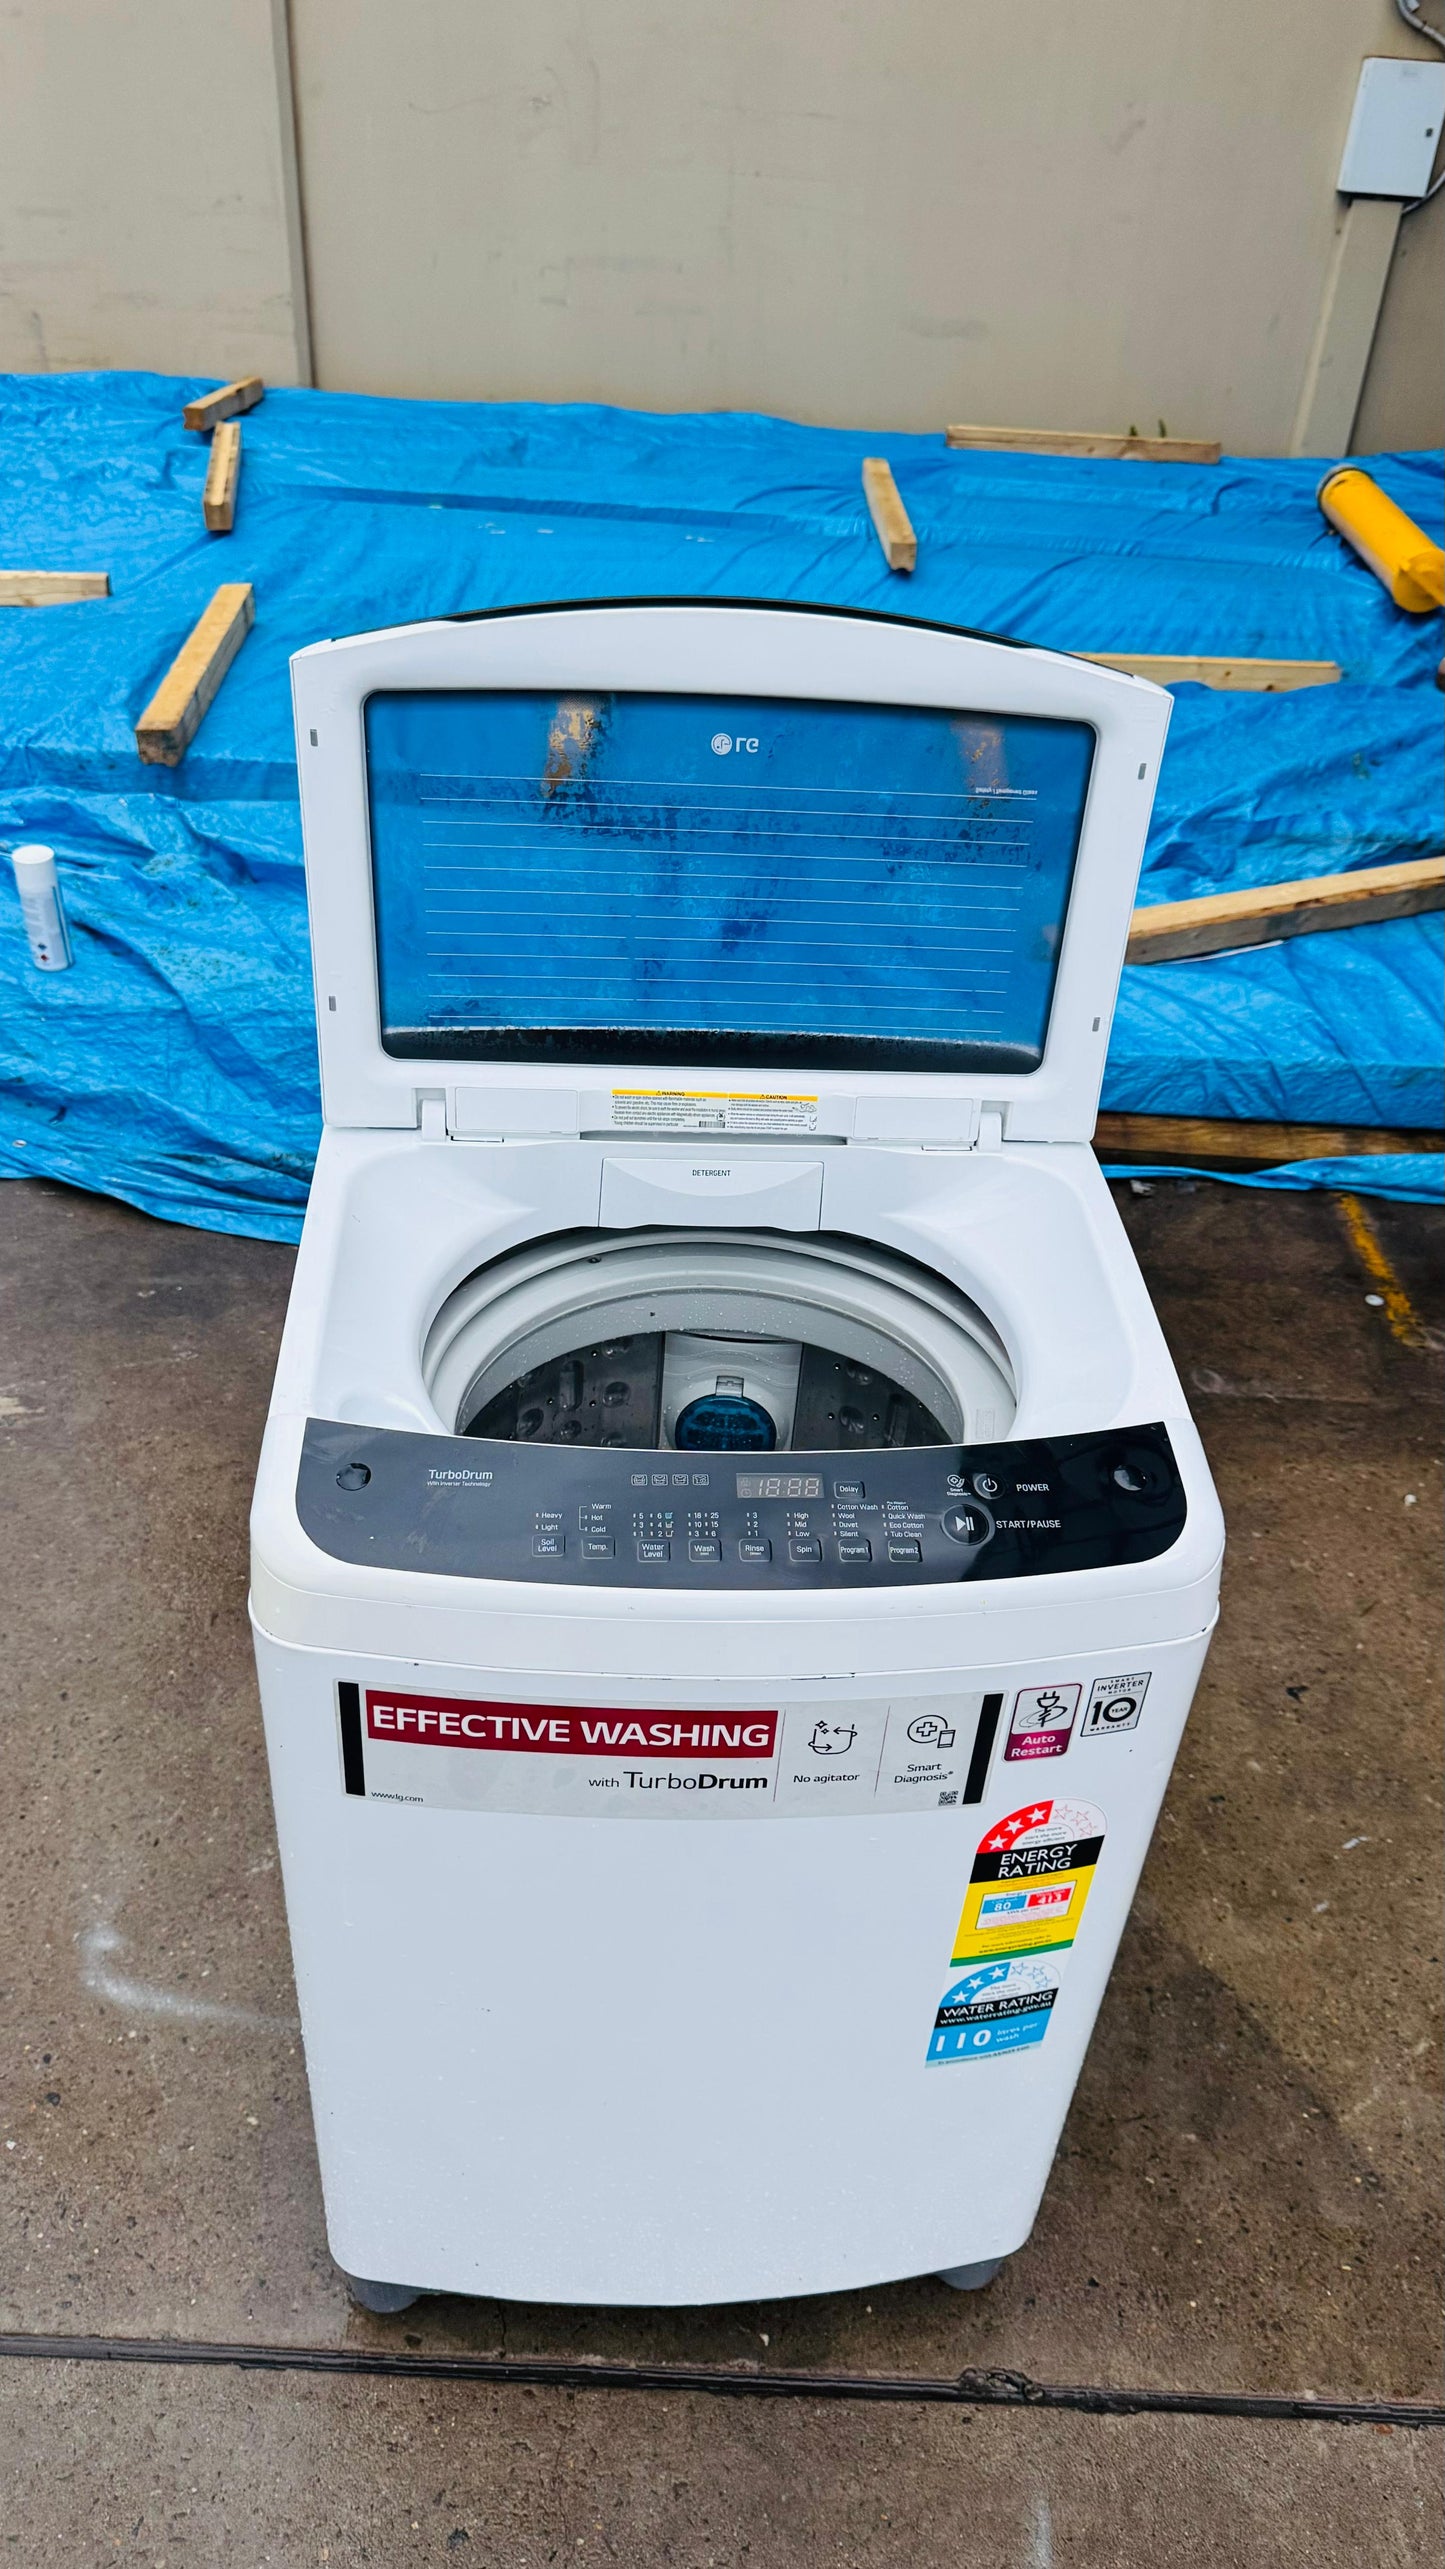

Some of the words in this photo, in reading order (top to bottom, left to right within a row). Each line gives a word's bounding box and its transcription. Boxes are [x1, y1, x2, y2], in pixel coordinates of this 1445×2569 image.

[692, 1169, 731, 1177] DETERGENT
[428, 1469, 493, 1480] TurboDrum
[839, 1485, 859, 1494] Delay
[1016, 1483, 1049, 1492] POWER
[541, 1511, 563, 1520] Heavy
[793, 1512, 809, 1520] High
[541, 1523, 558, 1532] Light
[591, 1525, 606, 1533] Cold
[996, 1519, 1061, 1529] START/PAUSE
[540, 1538, 555, 1546] Soil
[588, 1543, 609, 1551] Temp.
[745, 1544, 765, 1552] Rinse
[796, 1545, 812, 1554] Spin
[840, 1546, 865, 1555] Program
[889, 1547, 914, 1555] Program
[1097, 1680, 1144, 1692] INVERTER
[1091, 1697, 1137, 1725] 10
[372, 1705, 571, 1743] EFFECTIVE
[580, 1721, 770, 1748] WASHING
[1022, 1734, 1056, 1746] Auto
[1010, 1743, 1063, 1758] Restart
[906, 1763, 942, 1773] Smart
[588, 1776, 620, 1788] with
[623, 1771, 768, 1790] TurboDrum
[793, 1774, 811, 1783] No
[813, 1772, 860, 1785] agitator
[371, 1791, 424, 1803] www.lg.com
[1000, 1843, 1078, 1866] ENERGY
[997, 1857, 1072, 1879] RATING
[994, 1902, 1012, 1912] 80
[943, 2003, 995, 2018] WATER
[998, 1990, 1054, 2011] RATING
